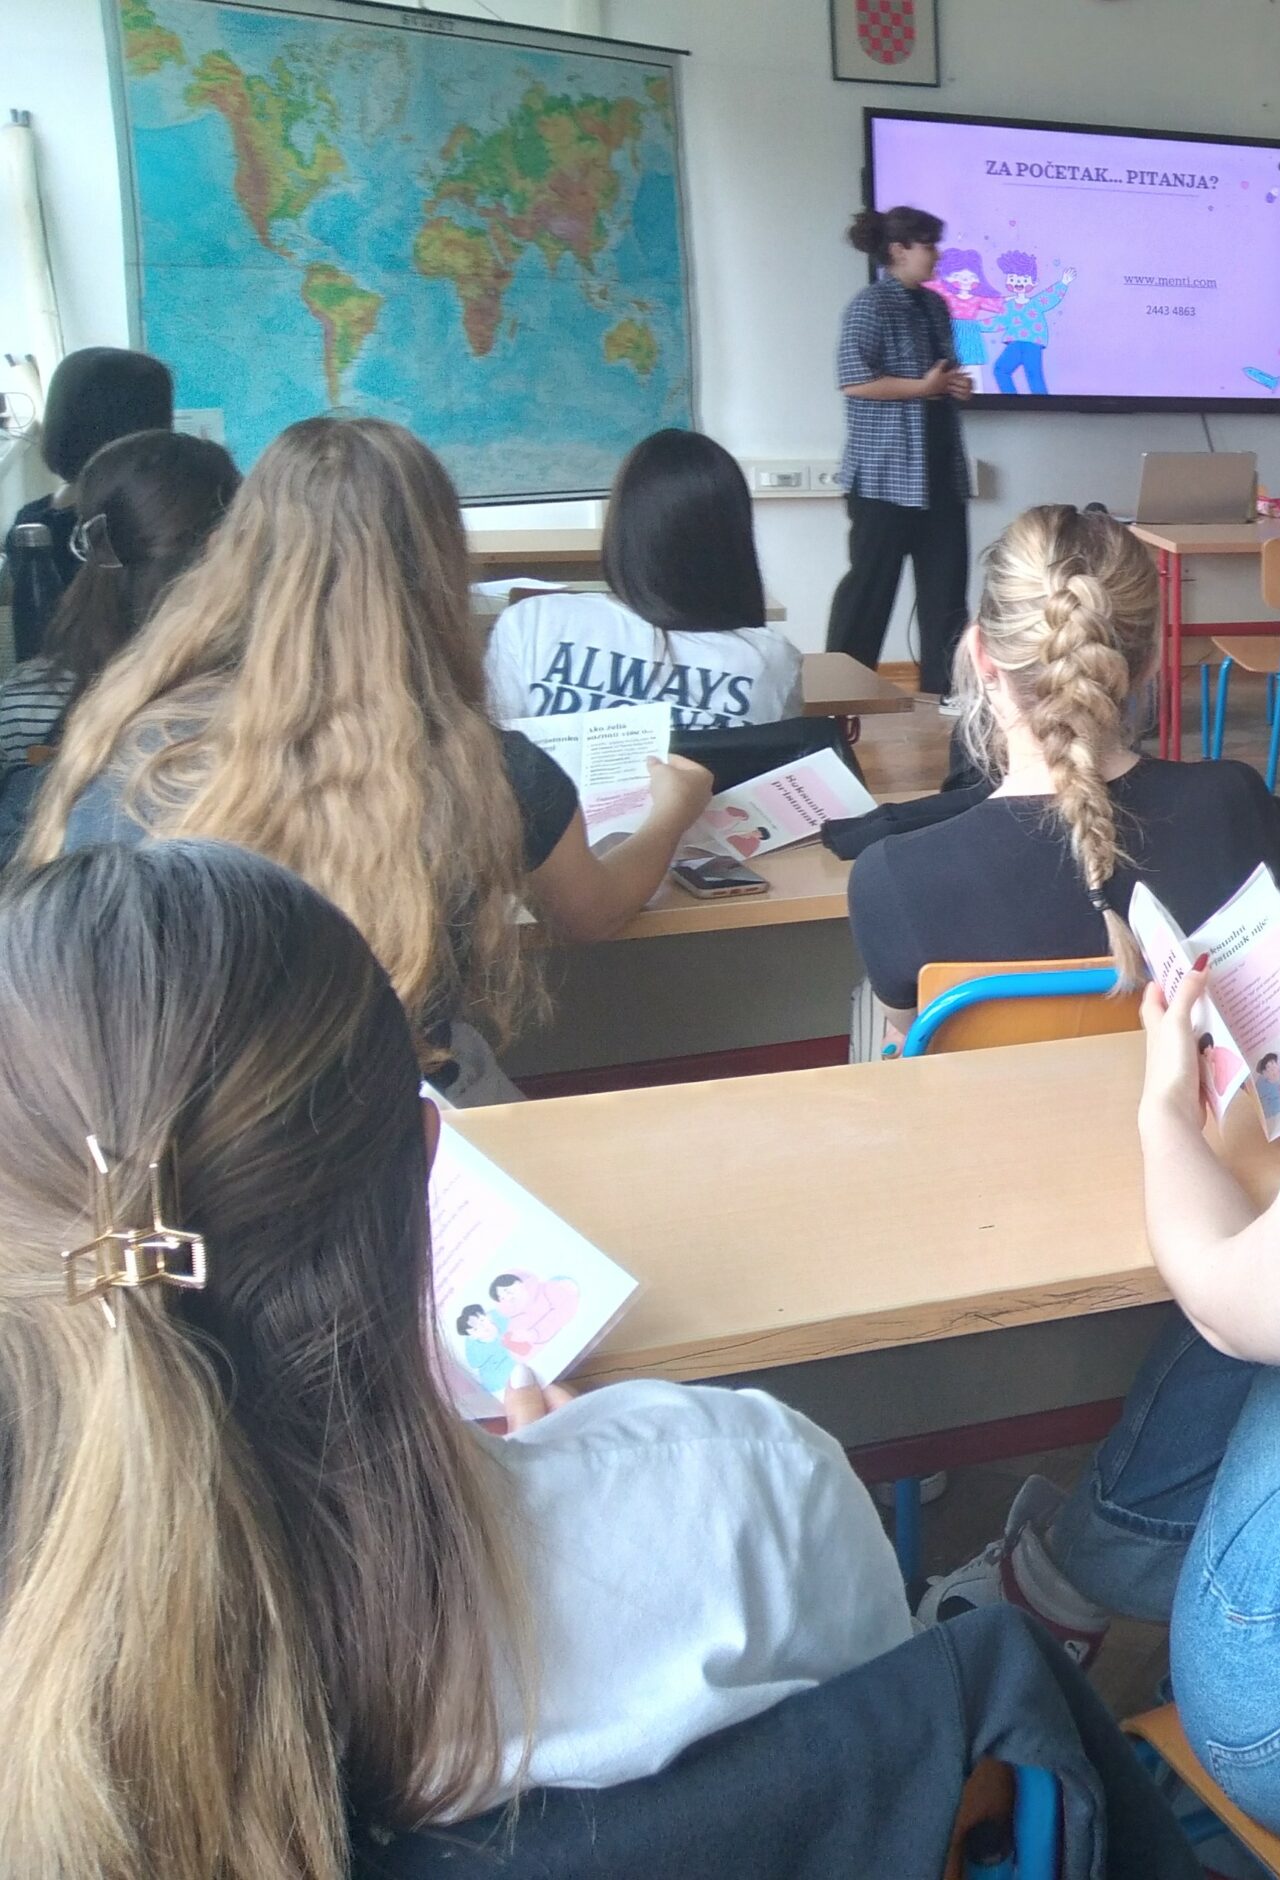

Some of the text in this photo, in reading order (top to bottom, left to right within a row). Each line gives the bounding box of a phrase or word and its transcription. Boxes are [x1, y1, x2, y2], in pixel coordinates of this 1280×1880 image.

[985, 160, 1219, 190] ZA POČETAK... PITANJA?
[1123, 275, 1217, 289] www.menti.com
[1146, 304, 1196, 317] 2443 4863
[541, 641, 754, 717] ALWAYS
